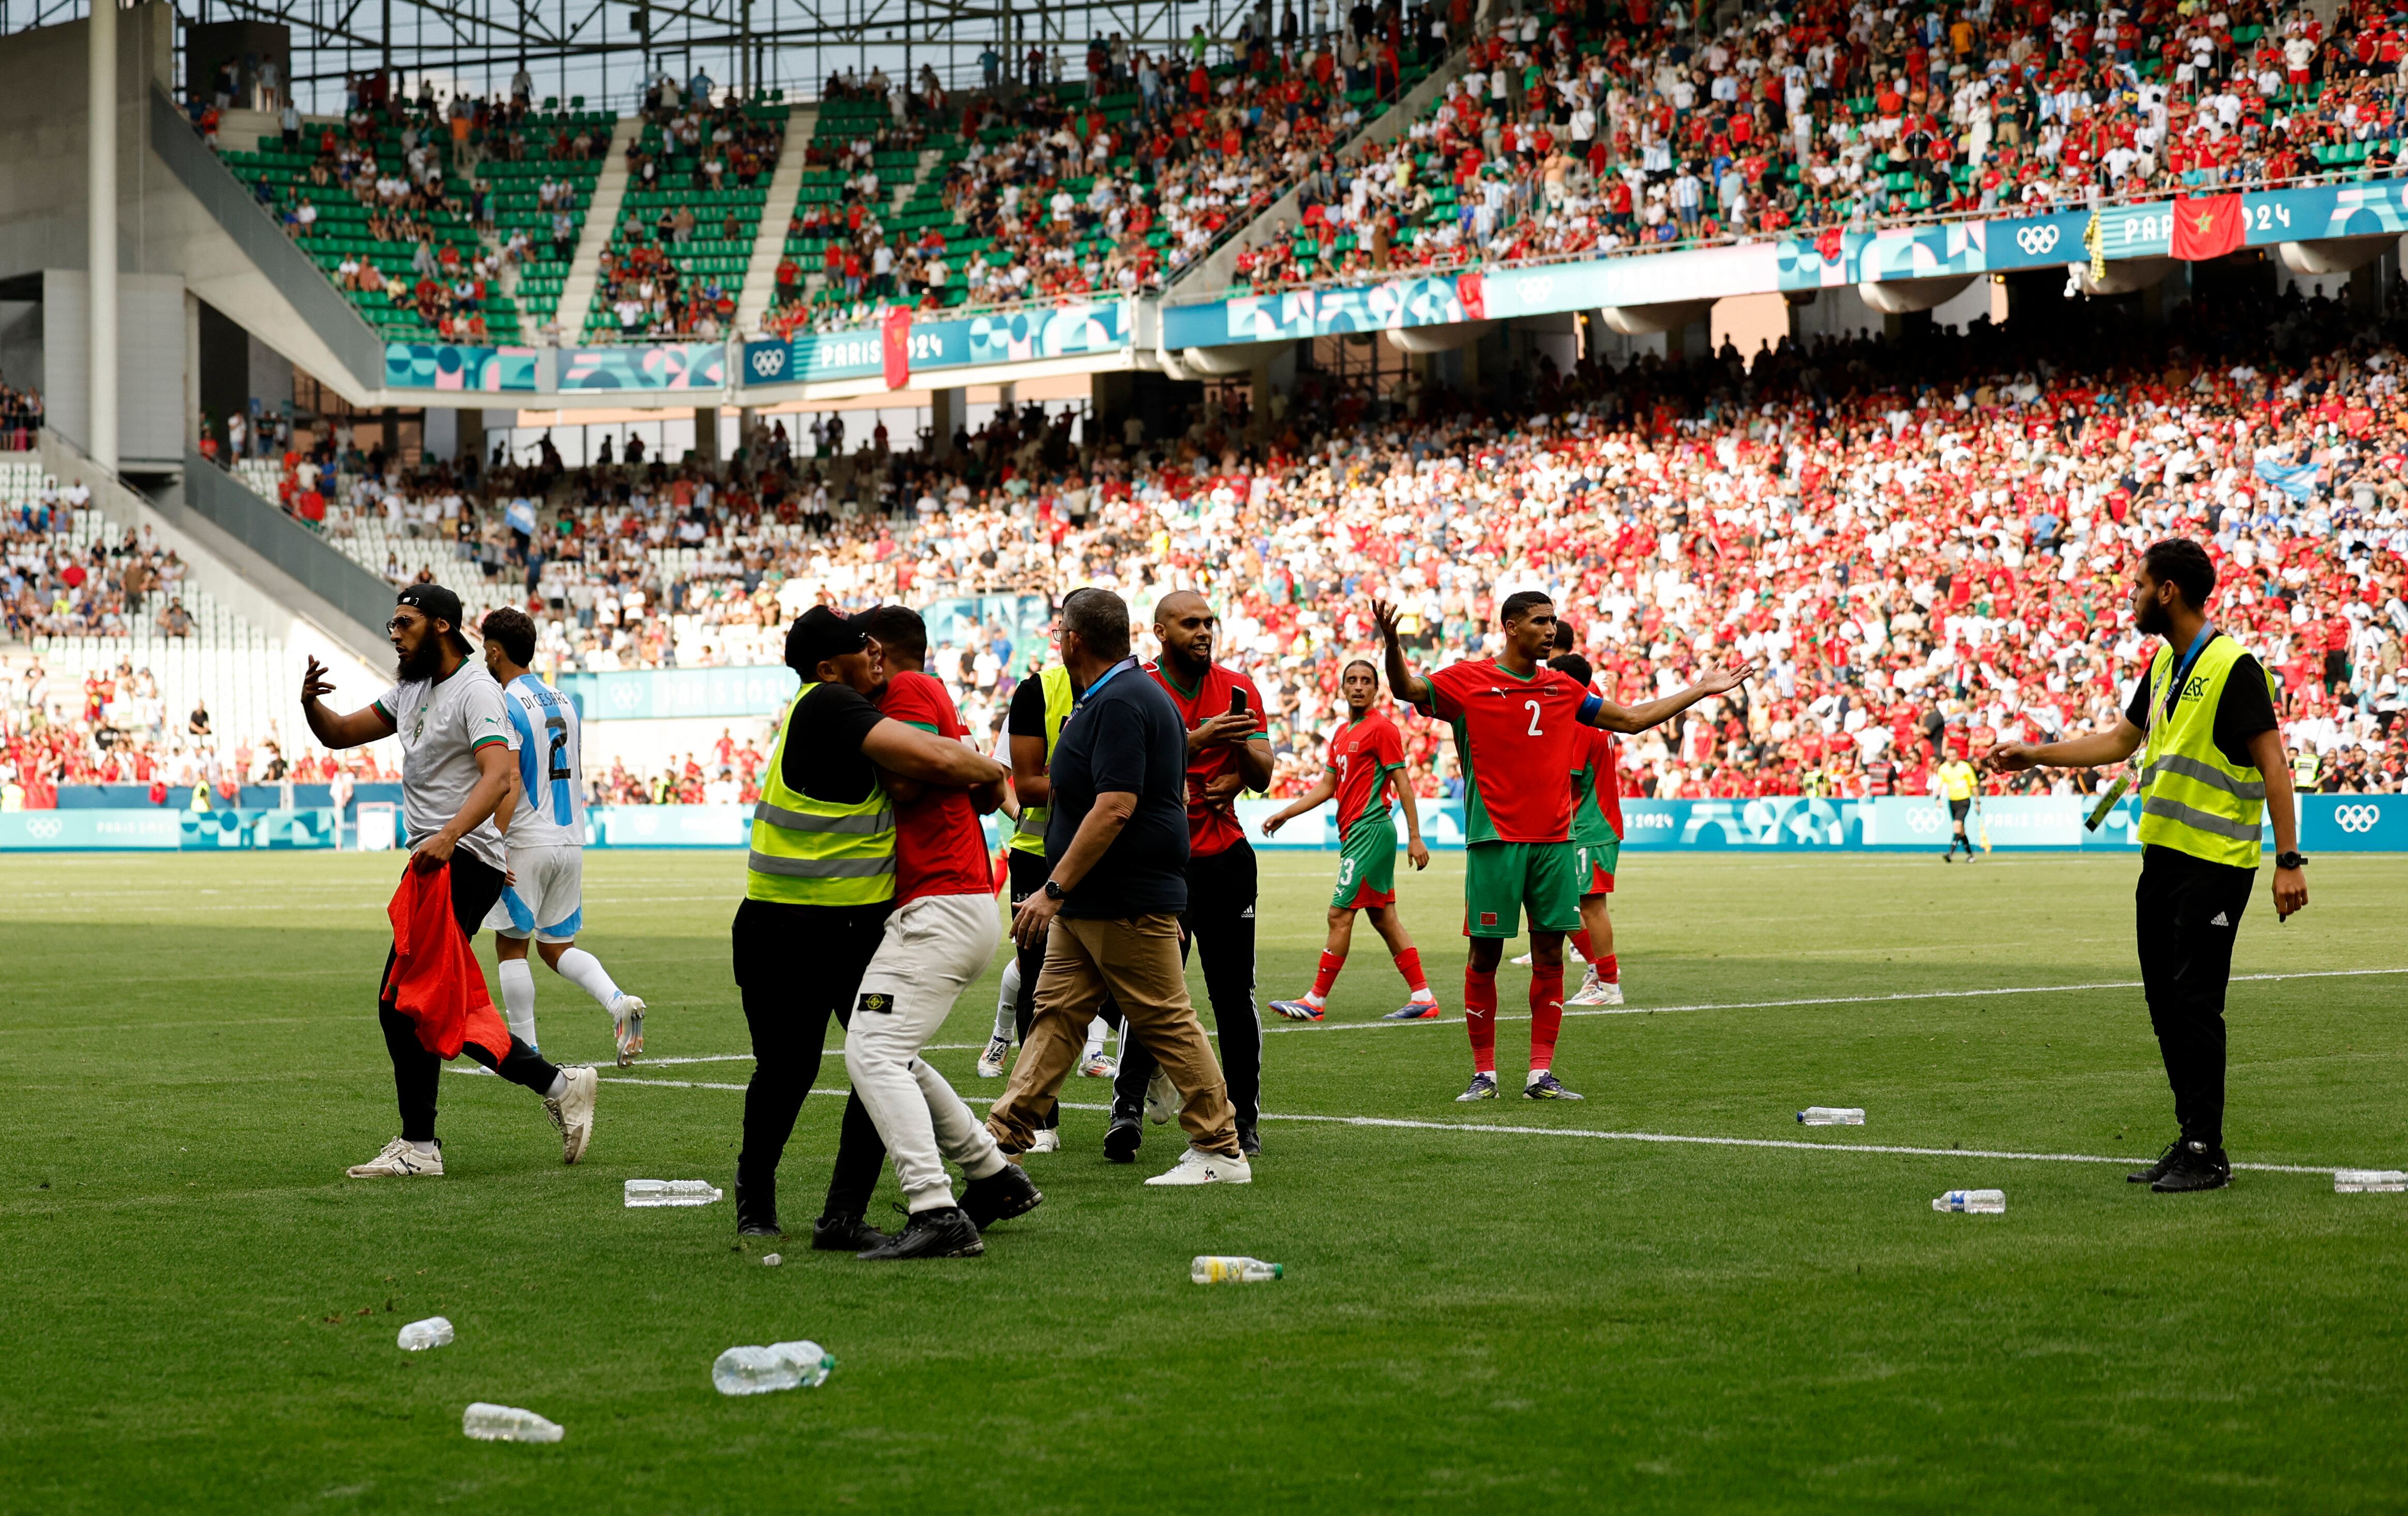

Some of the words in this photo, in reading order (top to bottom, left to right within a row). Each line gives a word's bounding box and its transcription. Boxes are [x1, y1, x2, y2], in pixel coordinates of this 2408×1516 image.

[2124, 214, 2174, 244] PAR
[2241, 203, 2291, 231] 024
[821, 339, 881, 369] PARIS
[906, 333, 943, 359] 024
[520, 696, 535, 710] DI
[533, 691, 568, 707] CESARE
[663, 678, 724, 708] PARIS
[733, 677, 790, 707] 2024
[1525, 700, 1543, 736] 2
[545, 717, 571, 780] 2
[1635, 813, 1674, 829] 2024
[1984, 813, 2028, 828] PARIS
[1336, 857, 1355, 886] 3
